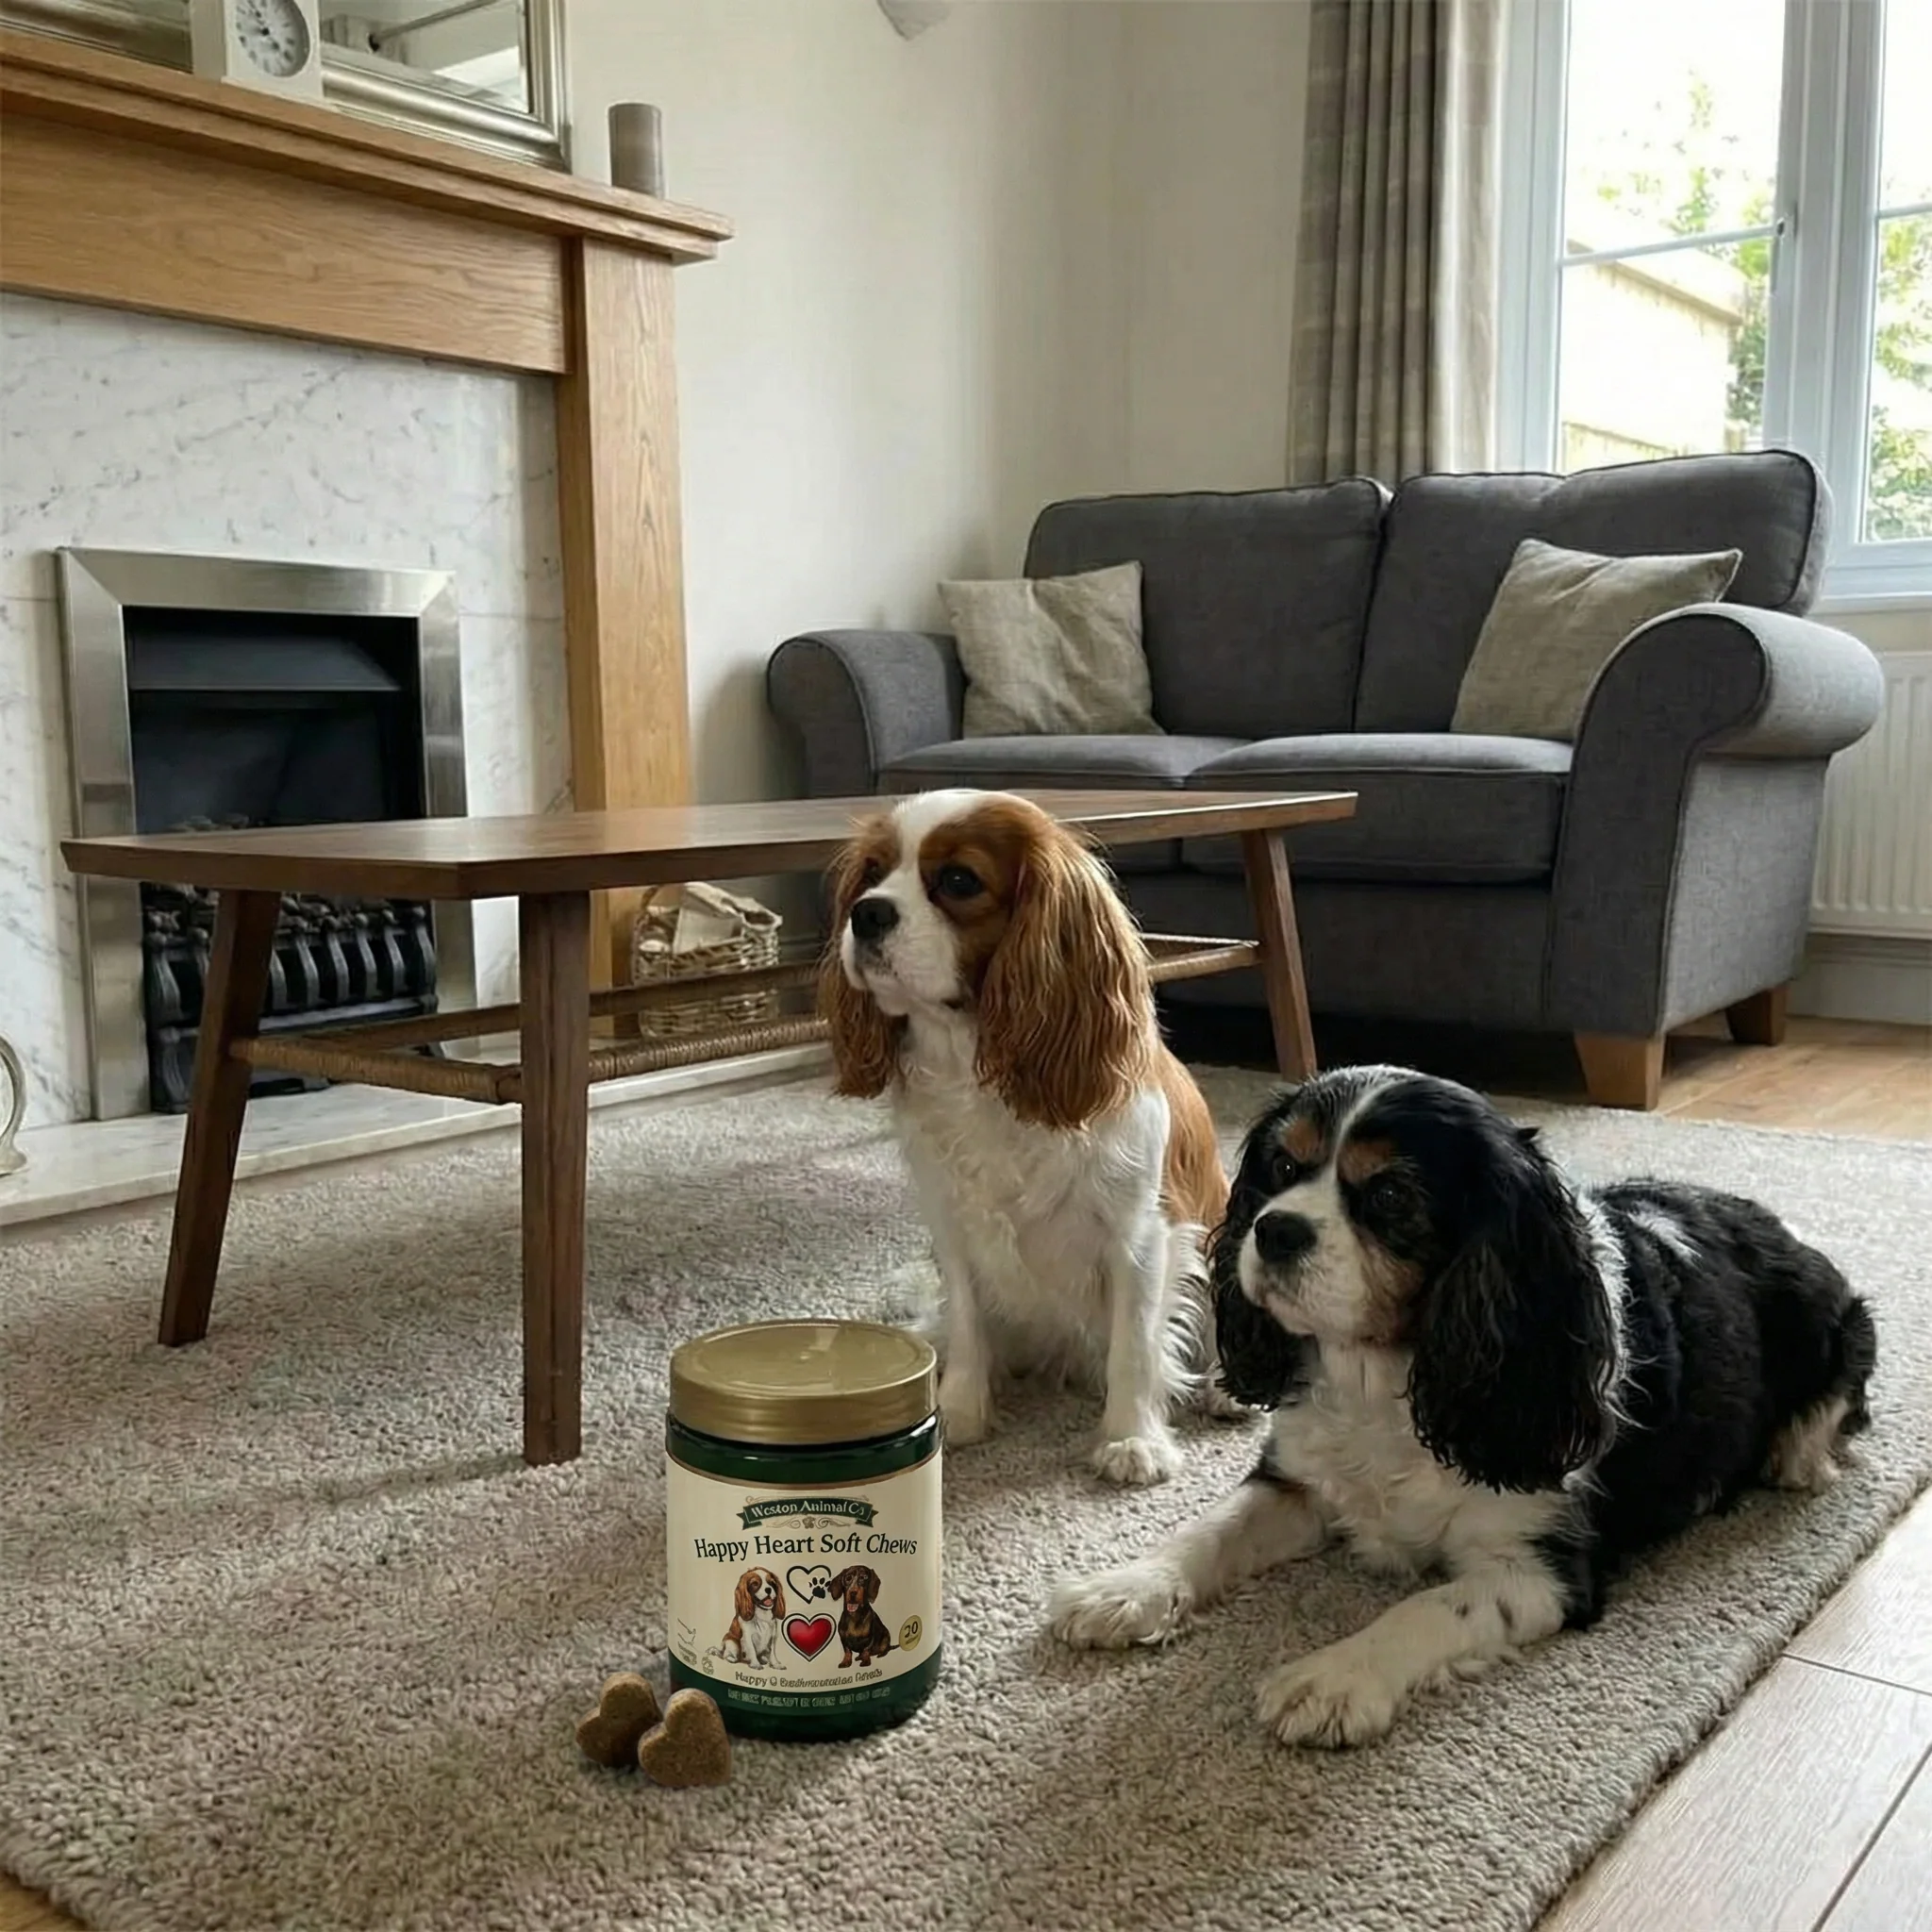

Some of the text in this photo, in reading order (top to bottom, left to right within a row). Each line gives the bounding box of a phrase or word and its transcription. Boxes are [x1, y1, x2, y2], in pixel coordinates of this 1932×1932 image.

[800, 1500, 847, 1513] Animal
[694, 1532, 918, 1562] Happy Heart Soft Chews
